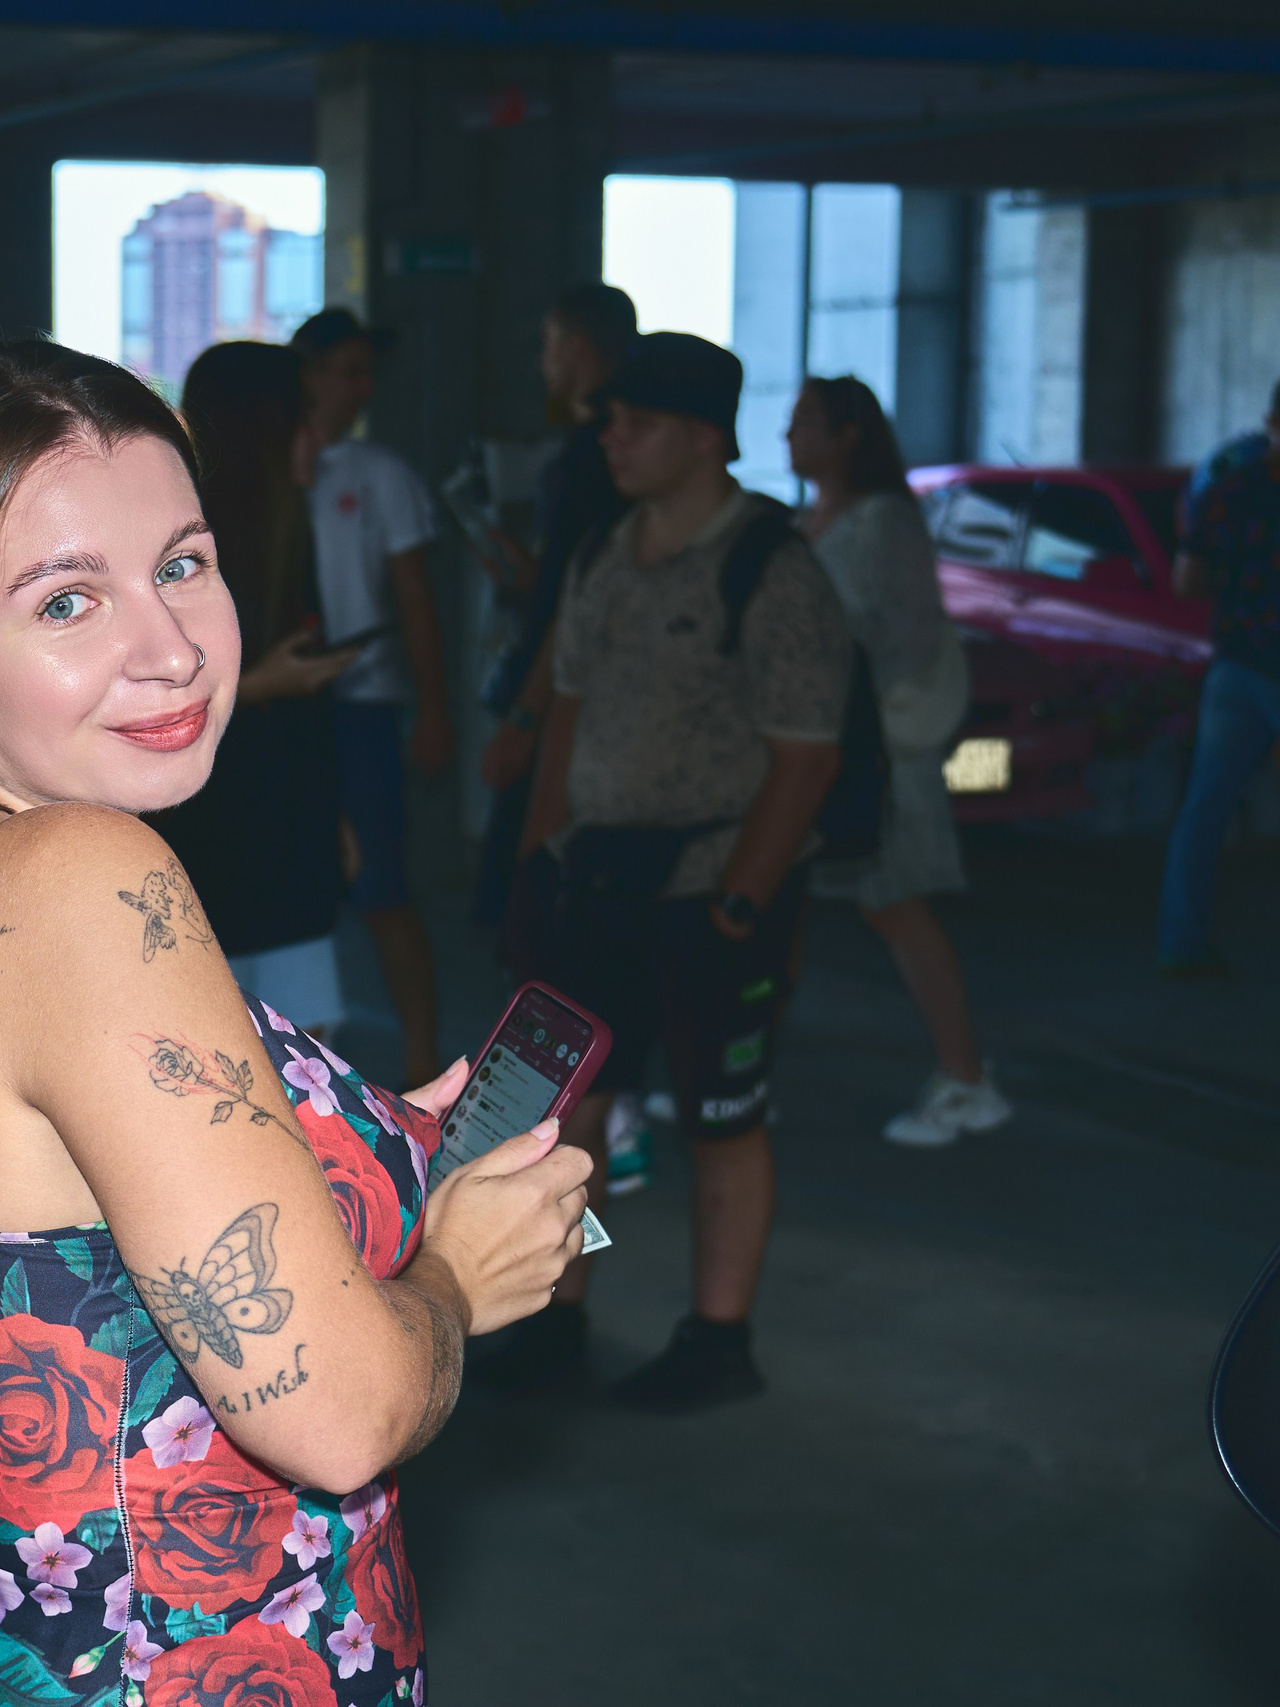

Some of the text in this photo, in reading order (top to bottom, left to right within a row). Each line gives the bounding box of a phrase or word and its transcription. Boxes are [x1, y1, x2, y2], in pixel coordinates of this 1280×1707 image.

[217, 1343, 309, 1414] As I Wish
